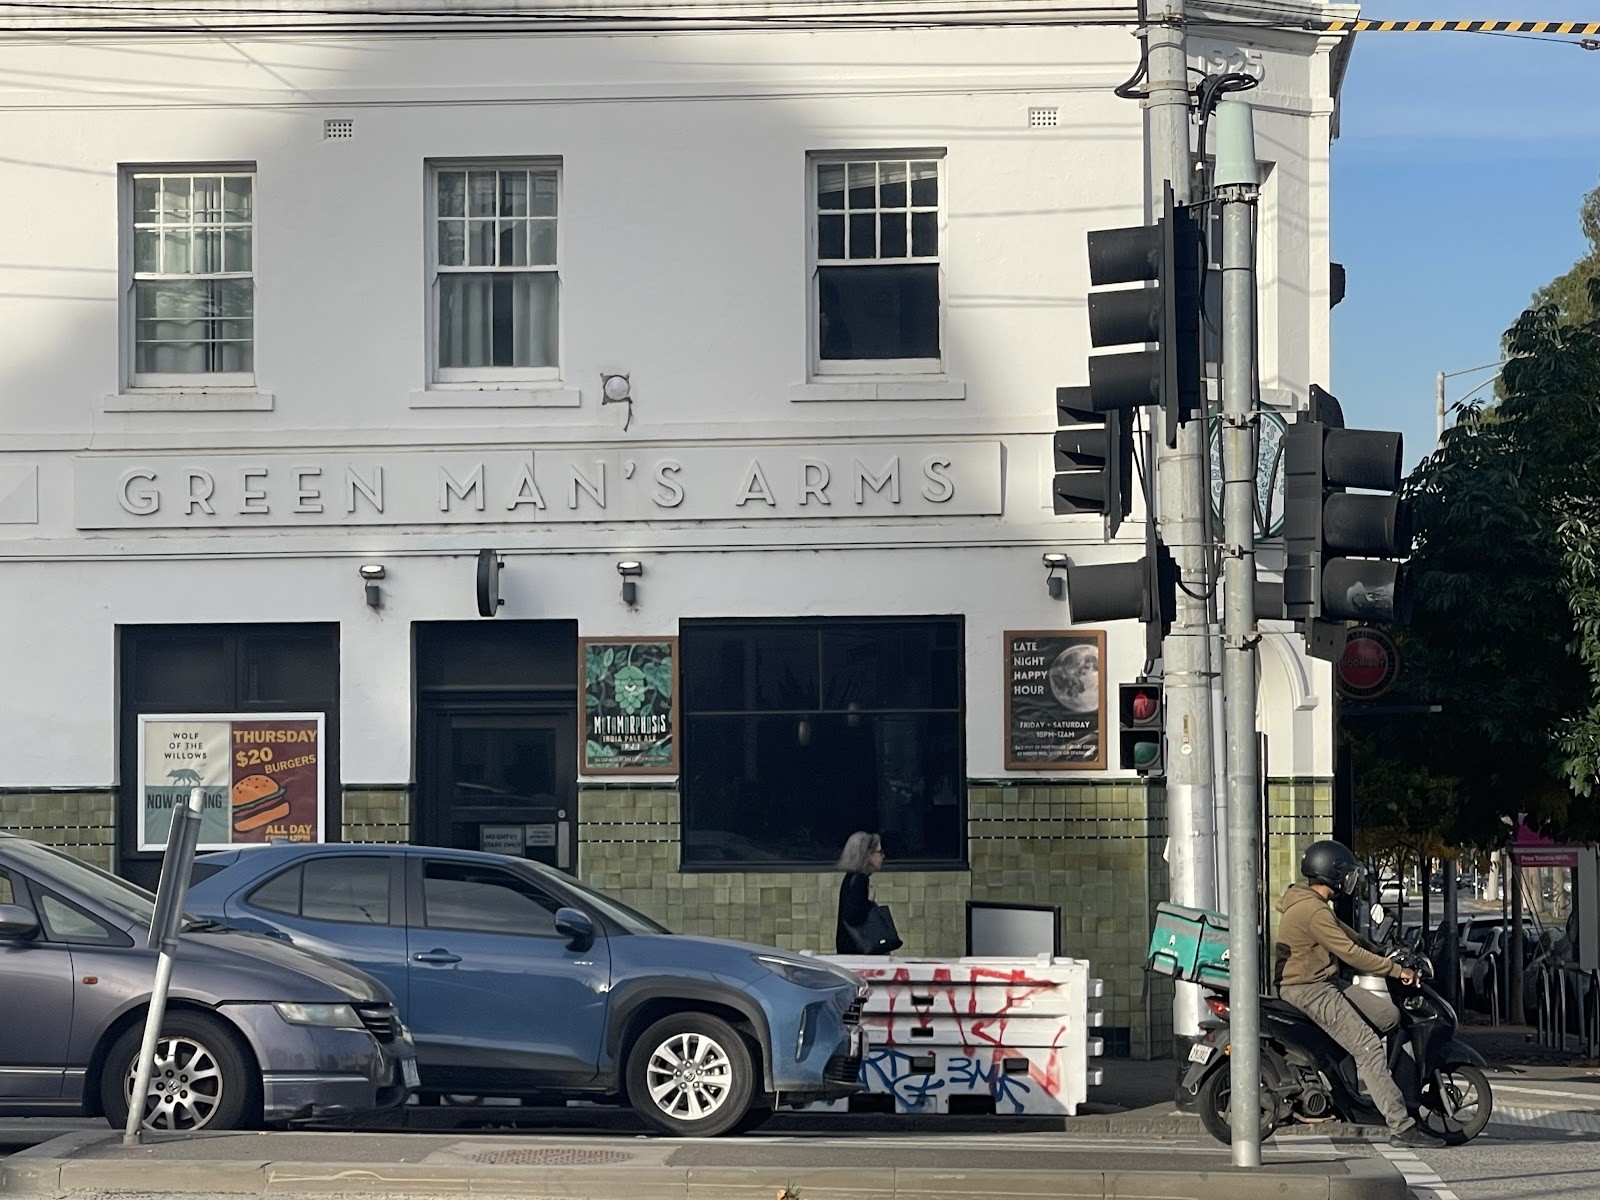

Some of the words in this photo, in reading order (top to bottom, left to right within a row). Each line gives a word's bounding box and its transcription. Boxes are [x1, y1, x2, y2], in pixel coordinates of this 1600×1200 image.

[118, 466, 384, 516] GREEN
[438, 460, 685, 511] MAN'S
[736, 456, 955, 506] ARMS
[1013, 642, 1038, 652] LATE
[1013, 656, 1045, 666] NIGHT
[1013, 670, 1048, 681] HAPPY
[1013, 685, 1045, 695] HOUR
[594, 714, 666, 734] METAMORPHOSIS
[1019, 721, 1046, 729] FRIDAY
[1052, 721, 1091, 729] SATURDAY
[172, 732, 200, 740] WOLF
[233, 730, 317, 744] THURSDAY
[602, 735, 622, 743] INDIA
[624, 735, 641, 743] PALE
[169, 742, 182, 750] OF
[184, 742, 204, 750] THE
[164, 752, 207, 760] WILLOWS
[235, 747, 273, 768] $20
[264, 754, 316, 774] BURGERS
[147, 794, 173, 809] NOW
[265, 824, 288, 834] ALL
[289, 824, 313, 834] DAY
